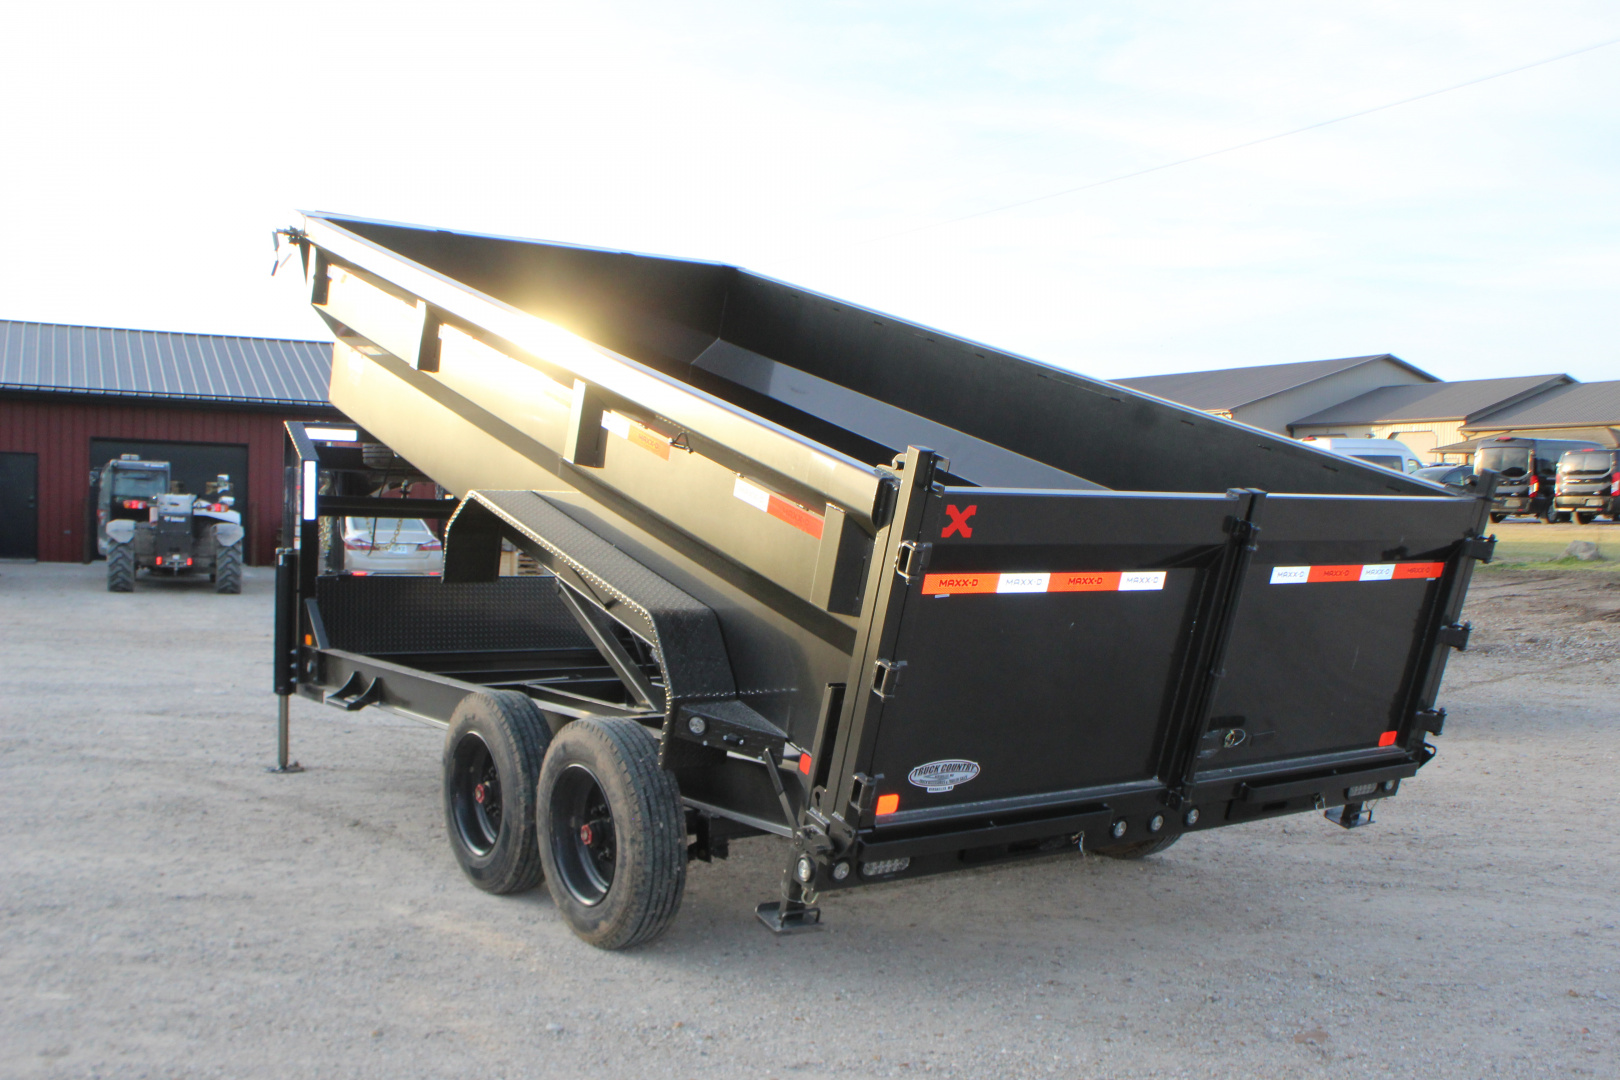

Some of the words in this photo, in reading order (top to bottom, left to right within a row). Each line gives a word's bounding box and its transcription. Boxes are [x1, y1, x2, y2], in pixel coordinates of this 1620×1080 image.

[938, 578, 979, 588] MAXX-D
[1005, 578, 1043, 586] MAXX-D
[1067, 577, 1103, 585] MAXX-D
[1126, 576, 1159, 584] MAXX-D
[914, 765, 940, 777] TRUCK
[941, 763, 976, 773] COUNTRY
